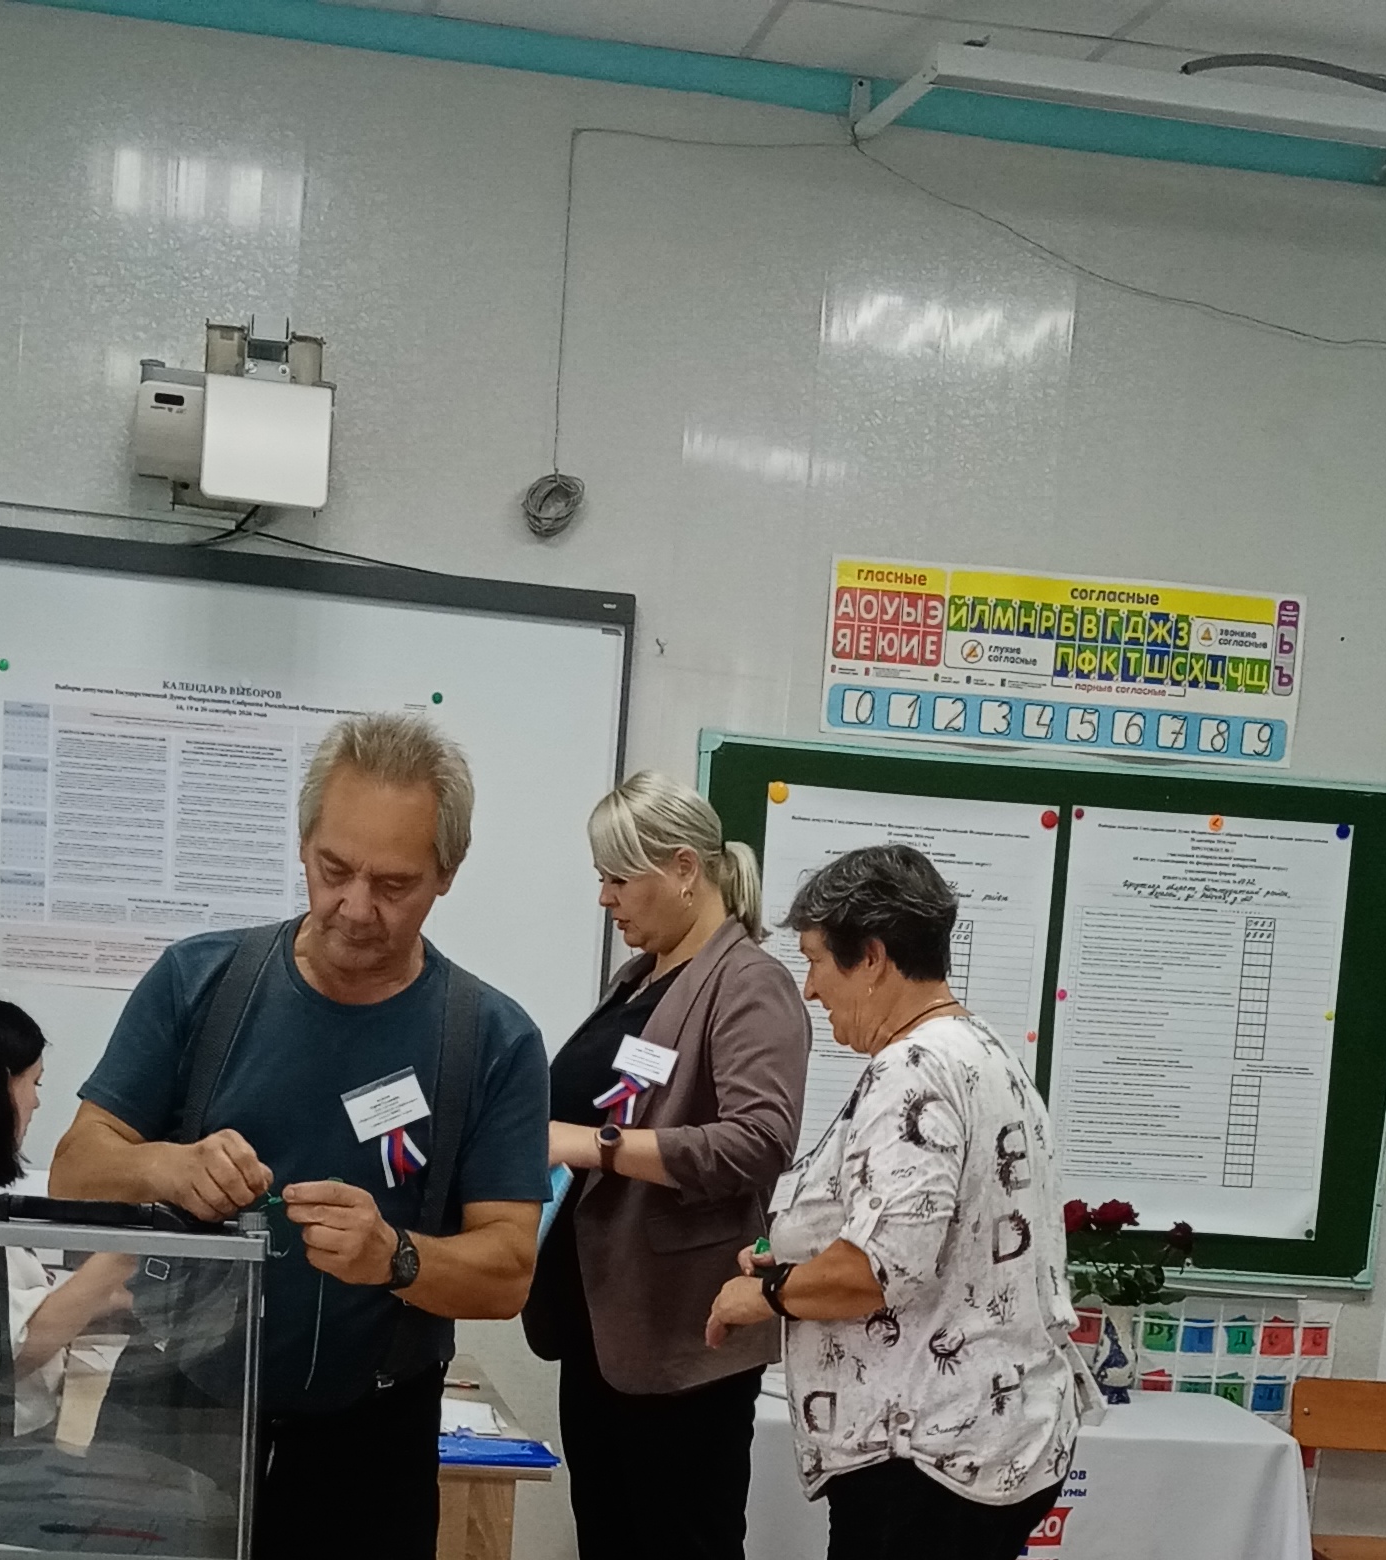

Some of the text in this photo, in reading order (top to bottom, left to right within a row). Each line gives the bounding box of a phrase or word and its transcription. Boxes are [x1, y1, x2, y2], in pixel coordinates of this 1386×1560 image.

[857, 569, 927, 585] гласные
[1071, 586, 1160, 605] согласные
[837, 593, 943, 625] А О У Ы Э
[949, 598, 1188, 646] Й Л М Н Р Б В Г Д Ж З
[836, 626, 937, 660] Я Ё Ю И Е
[1219, 638, 1268, 649] согласные
[988, 655, 1037, 666] согласные
[1056, 648, 1268, 690] П Ф К Т Ш С Х Ц Ч Щ
[163, 681, 227, 694] КАЛЕНДАРЬ
[230, 686, 282, 699] ВЫБОРОВ
[1075, 684, 1167, 697] парные согласные
[856, 690, 1273, 755] 0 1 2 3 4 5 6 7 8 9
